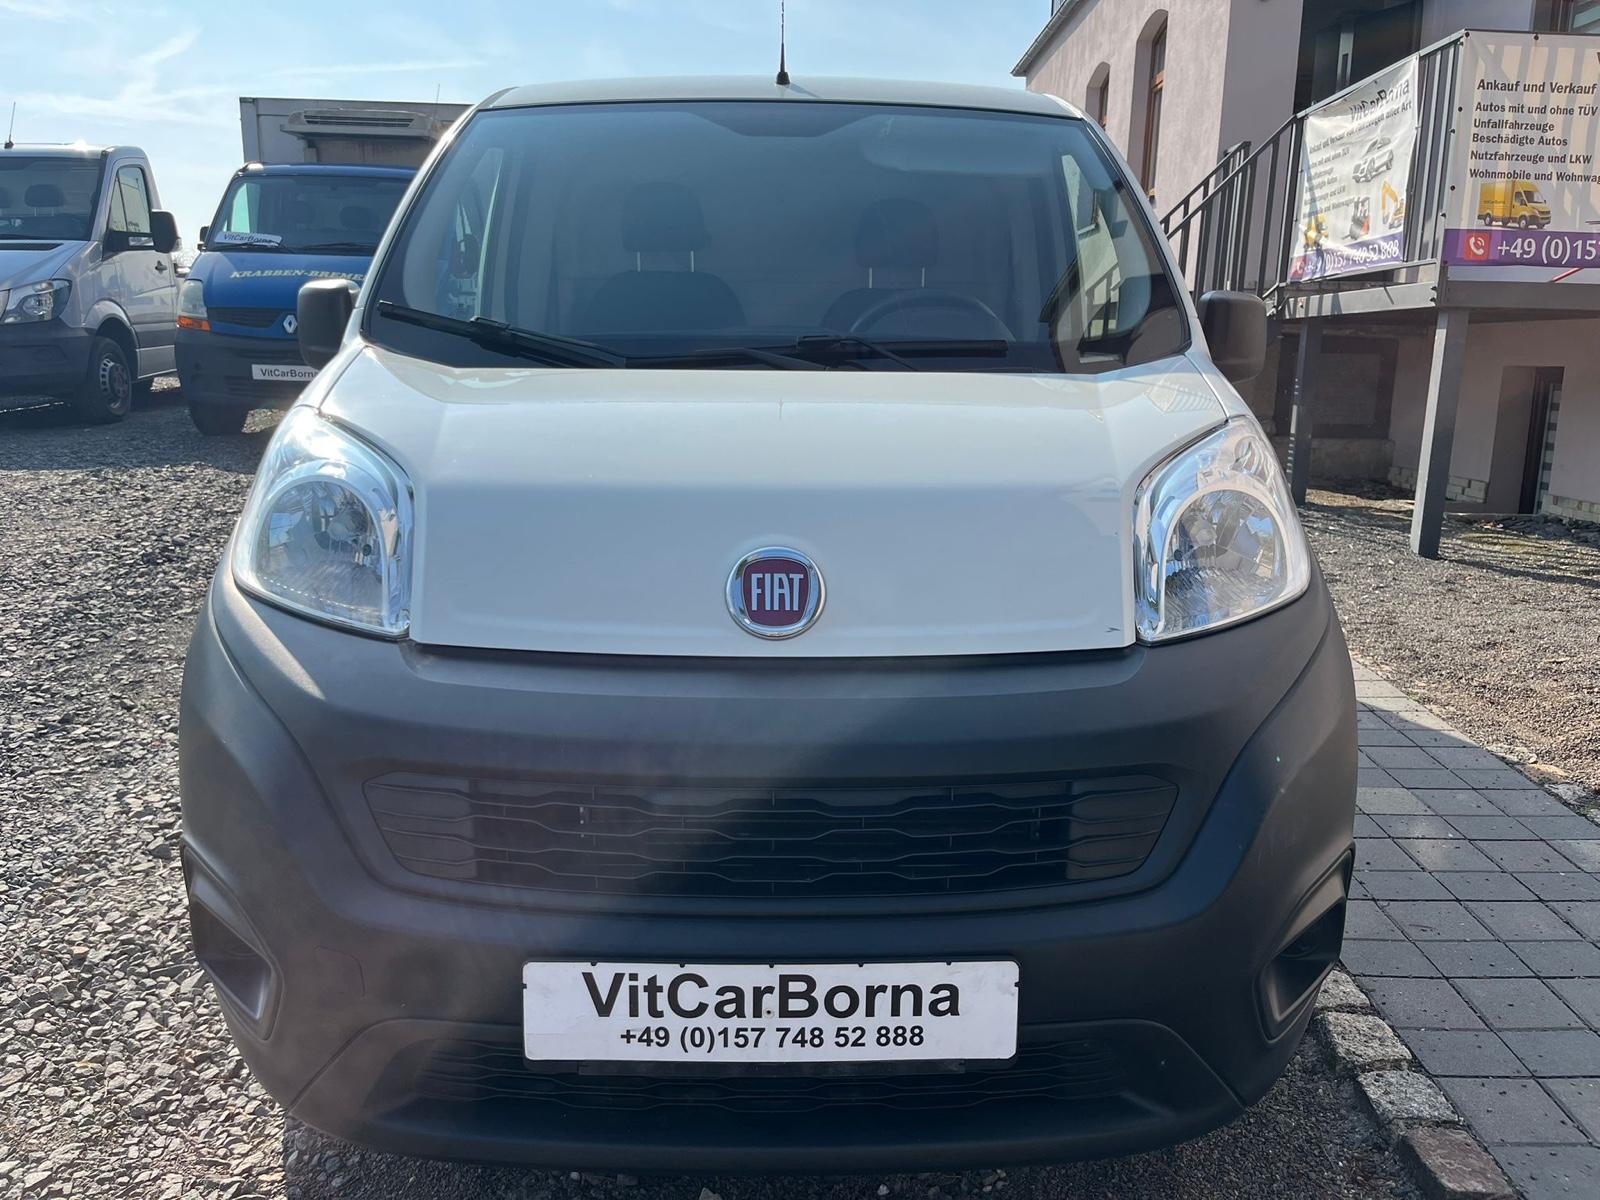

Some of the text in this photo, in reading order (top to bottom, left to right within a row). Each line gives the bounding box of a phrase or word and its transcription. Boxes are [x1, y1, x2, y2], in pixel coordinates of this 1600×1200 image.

[1477, 79, 1597, 95] Ankauf und Verkauf
[1475, 102, 1598, 117] Autos mit und ohne TÜV
[1473, 118, 1555, 133] Unfallfahrzeuge
[1472, 133, 1568, 147] Beschädigte Autos
[1470, 150, 1593, 164] Nutzfahrzeuge und LKW
[1469, 168, 1531, 180] Wohnmobile
[1534, 171, 1553, 181] und
[1497, 235, 1600, 265] +49 (0)15
[751, 573, 804, 611] FIAT
[582, 972, 960, 1019] VitCarBorna
[620, 1025, 924, 1054] +49 (0)157 748 52 888
